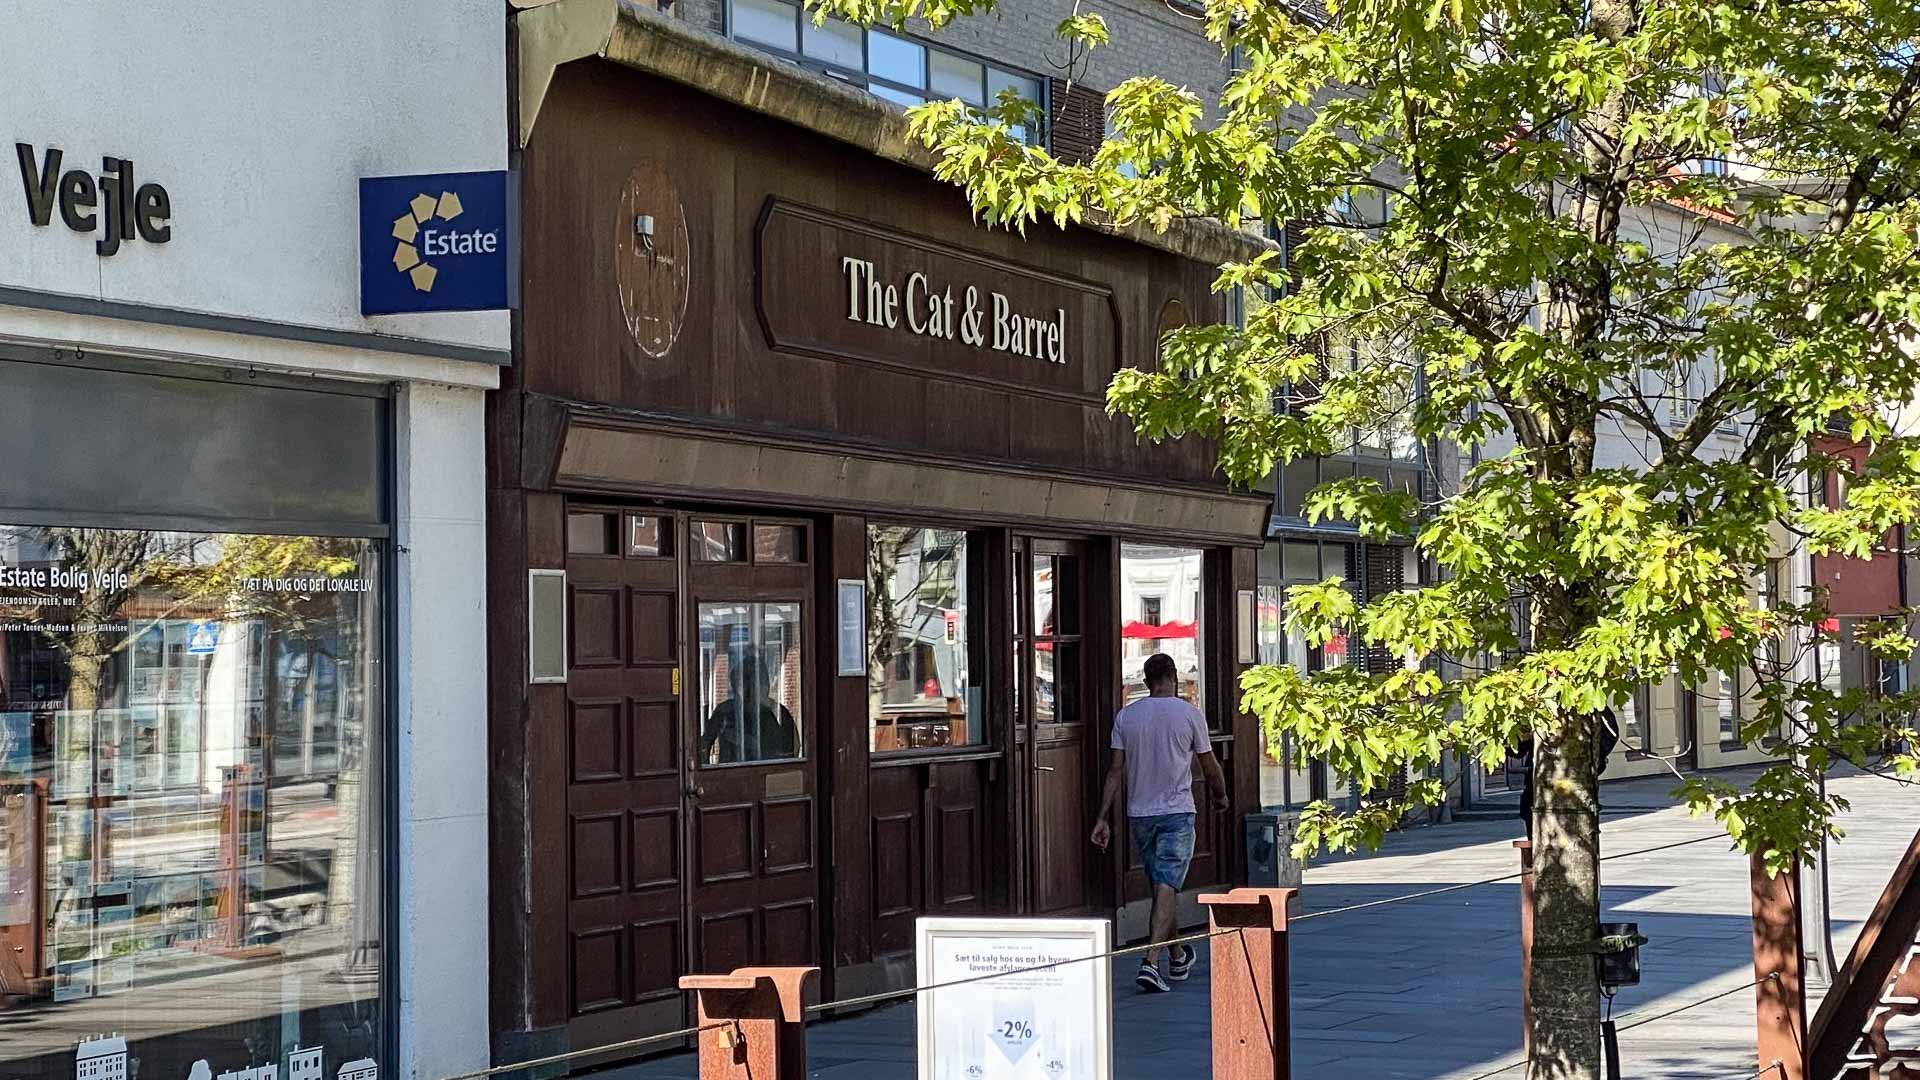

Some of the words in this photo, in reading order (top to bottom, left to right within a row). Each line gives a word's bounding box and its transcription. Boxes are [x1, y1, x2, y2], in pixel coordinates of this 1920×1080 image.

[15, 142, 171, 257] Vejle
[424, 229, 497, 255] Estate
[842, 256, 899, 329] The
[906, 272, 954, 340] Cat
[960, 285, 985, 347] &
[991, 291, 1066, 364] Barrel
[0, 566, 46, 588] Estate
[50, 566, 88, 594] Bolig
[92, 567, 128, 595] Vejle
[262, 575, 274, 591] PÅ
[275, 578, 292, 591] DIG
[293, 578, 307, 592] OG
[309, 578, 325, 592] DET
[327, 579, 359, 592] LOKALE
[360, 579, 373, 592] LIV
[969, 963, 998, 972] laveste
[971, 954, 980, 962] til
[982, 954, 998, 964] salg
[1000, 954, 1012, 963] hos
[1025, 956, 1036, 965] og
[997, 1020, 1032, 1039] -2%
[965, 1065, 983, 1075] -6%
